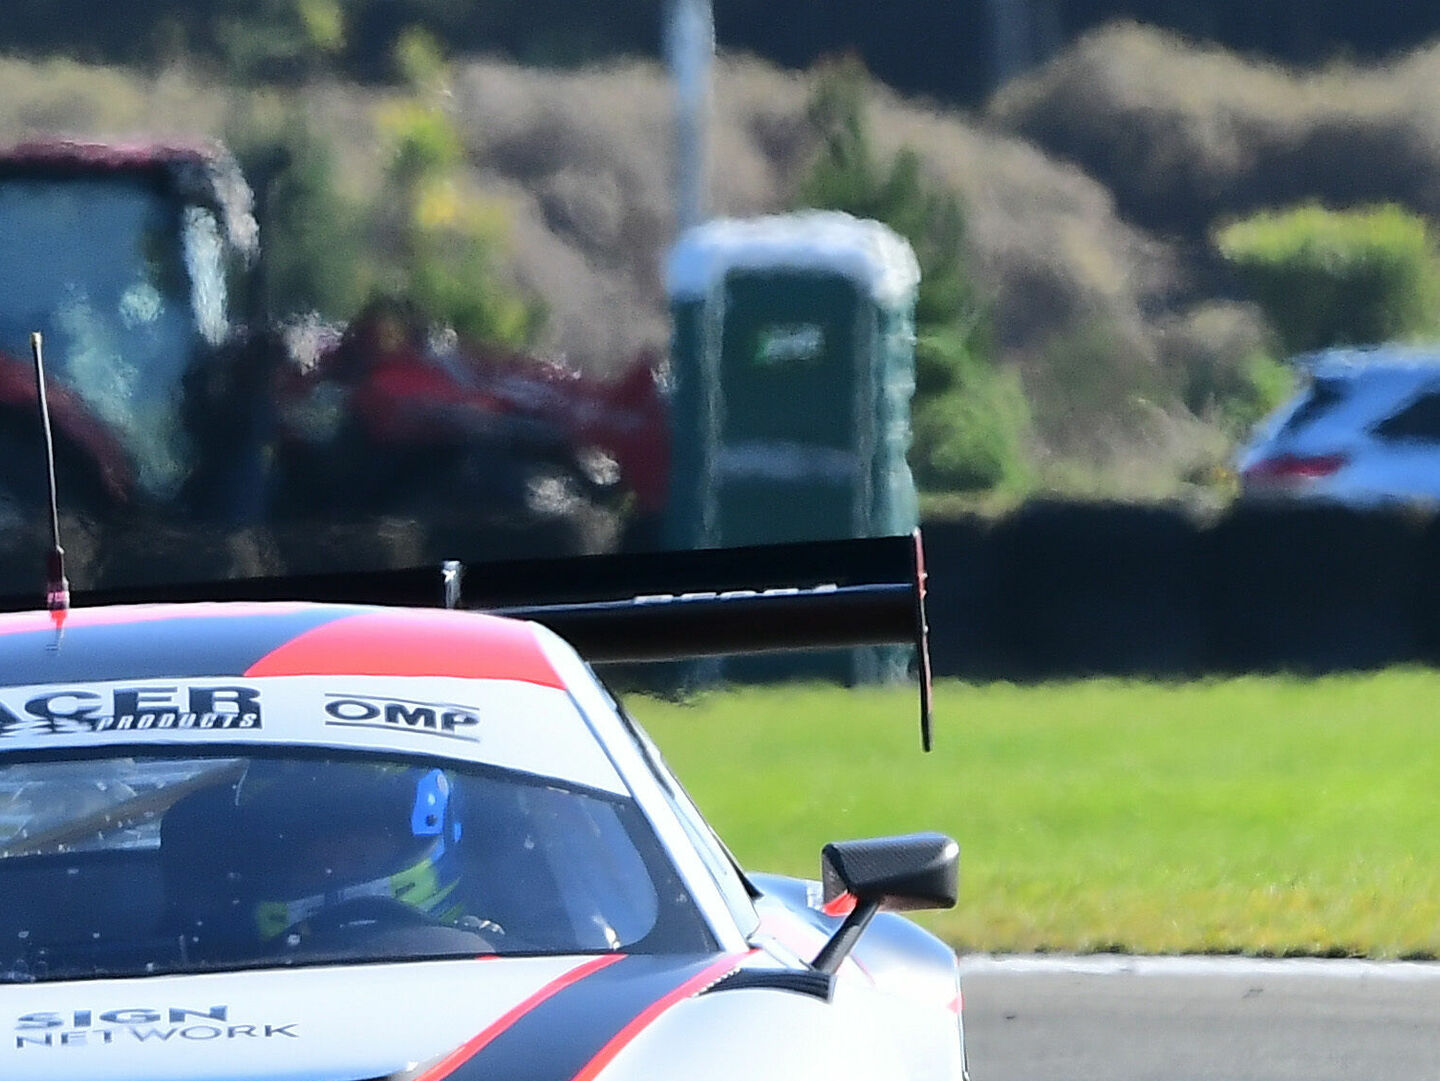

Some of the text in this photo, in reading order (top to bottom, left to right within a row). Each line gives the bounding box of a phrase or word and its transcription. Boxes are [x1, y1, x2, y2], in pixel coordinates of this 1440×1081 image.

[96, 713, 258, 732] PRODUCTS
[325, 700, 480, 732] OMP
[15, 1005, 228, 1030] SIGN
[16, 1024, 299, 1048] NETWORK
